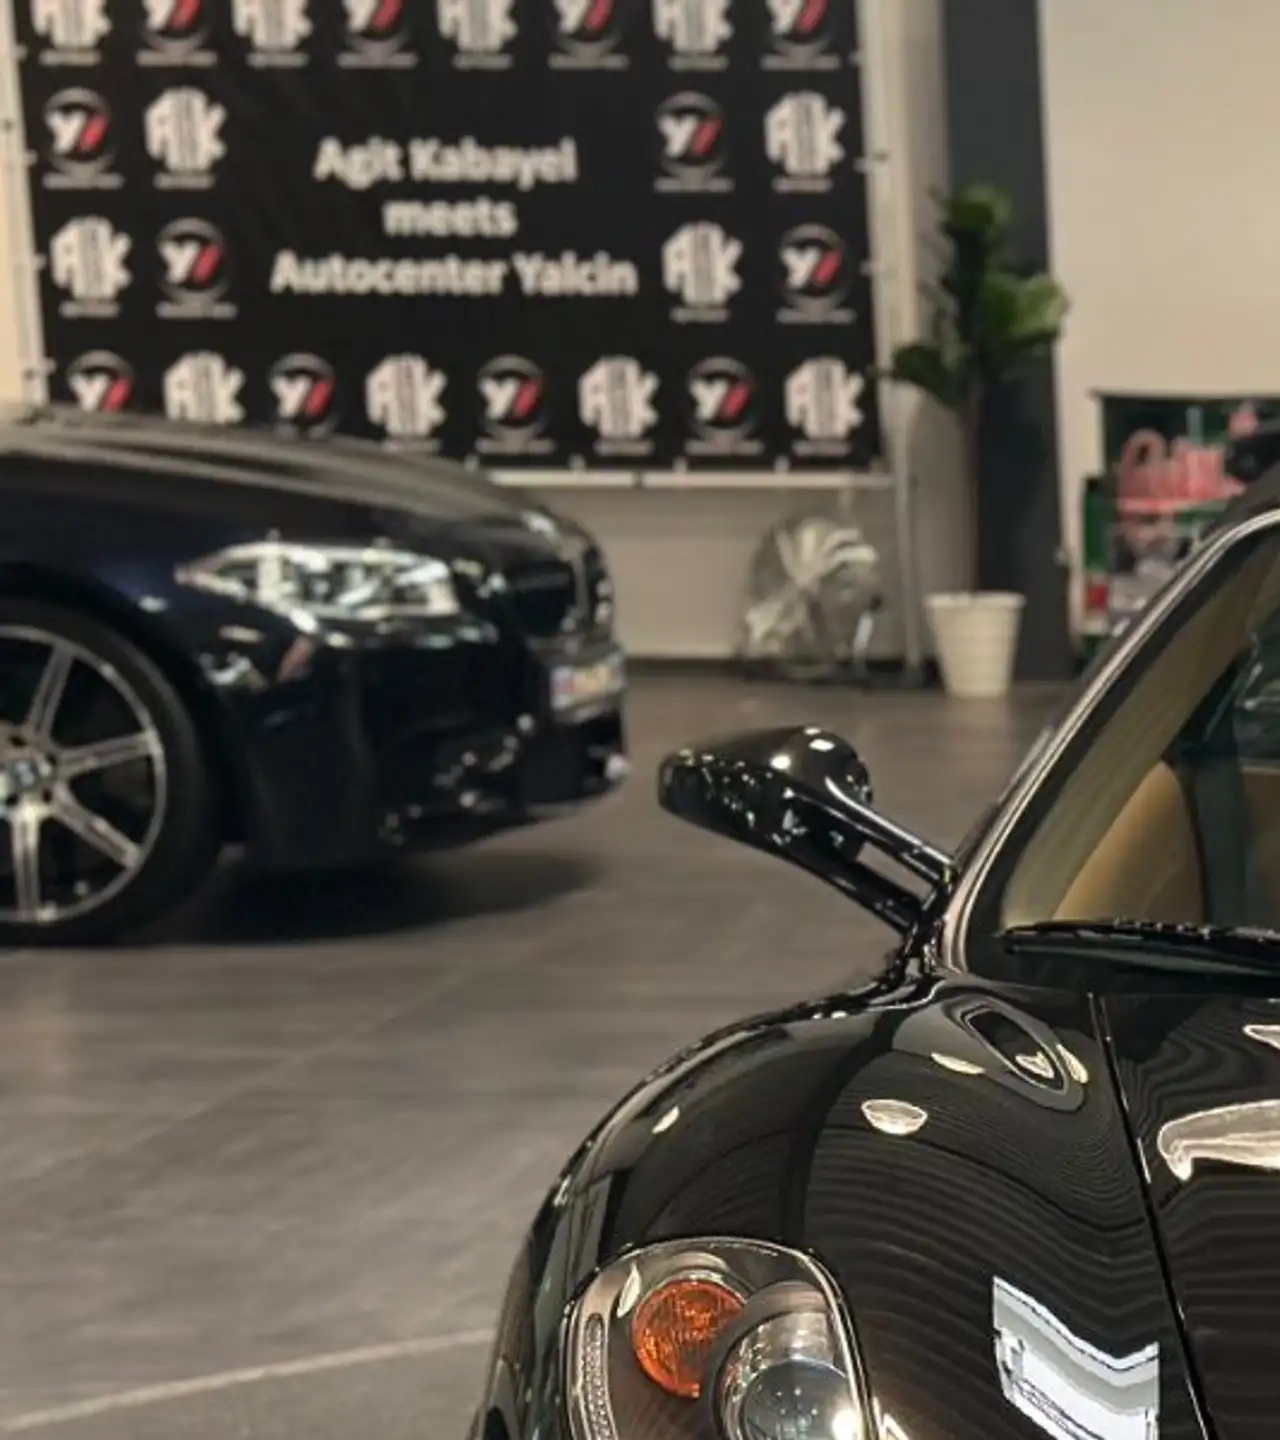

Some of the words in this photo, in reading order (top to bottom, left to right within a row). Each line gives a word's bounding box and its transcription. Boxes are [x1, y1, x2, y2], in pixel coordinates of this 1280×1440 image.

[314, 137, 403, 189] Agit
[409, 137, 577, 190] Kabayel
[383, 197, 518, 236] meets
[270, 250, 508, 294] Autocenter
[512, 251, 638, 295] Yalcin
